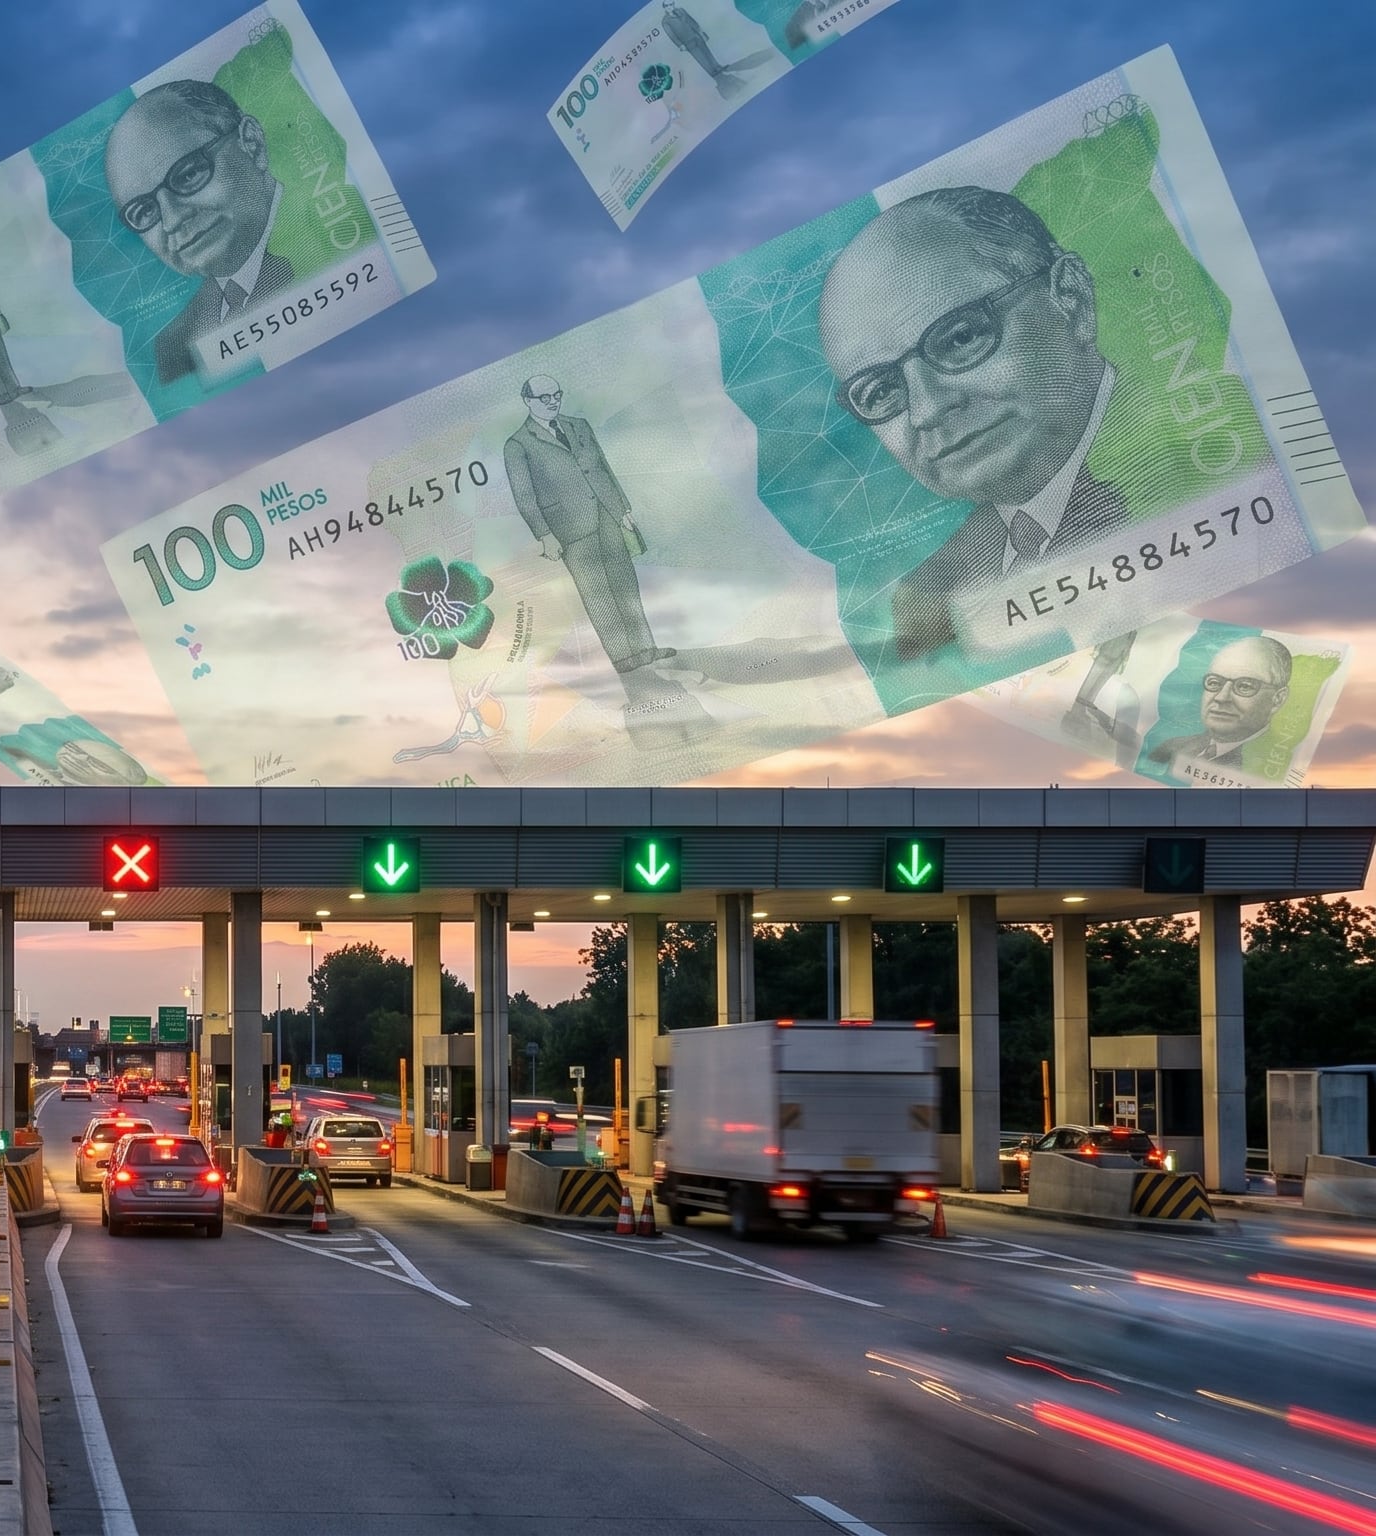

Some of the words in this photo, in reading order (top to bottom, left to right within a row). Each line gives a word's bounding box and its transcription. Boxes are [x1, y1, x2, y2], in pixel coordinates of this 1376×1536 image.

[556, 74, 599, 129] 100
[301, 161, 361, 250] CIEN
[218, 262, 379, 360] AE55085592
[1152, 336, 1243, 476] CIEN
[260, 481, 294, 507] MIL
[266, 487, 328, 526] PESOS
[288, 460, 490, 561] AH94844570
[133, 503, 265, 607] 100
[1004, 495, 1275, 627] AE54884570
